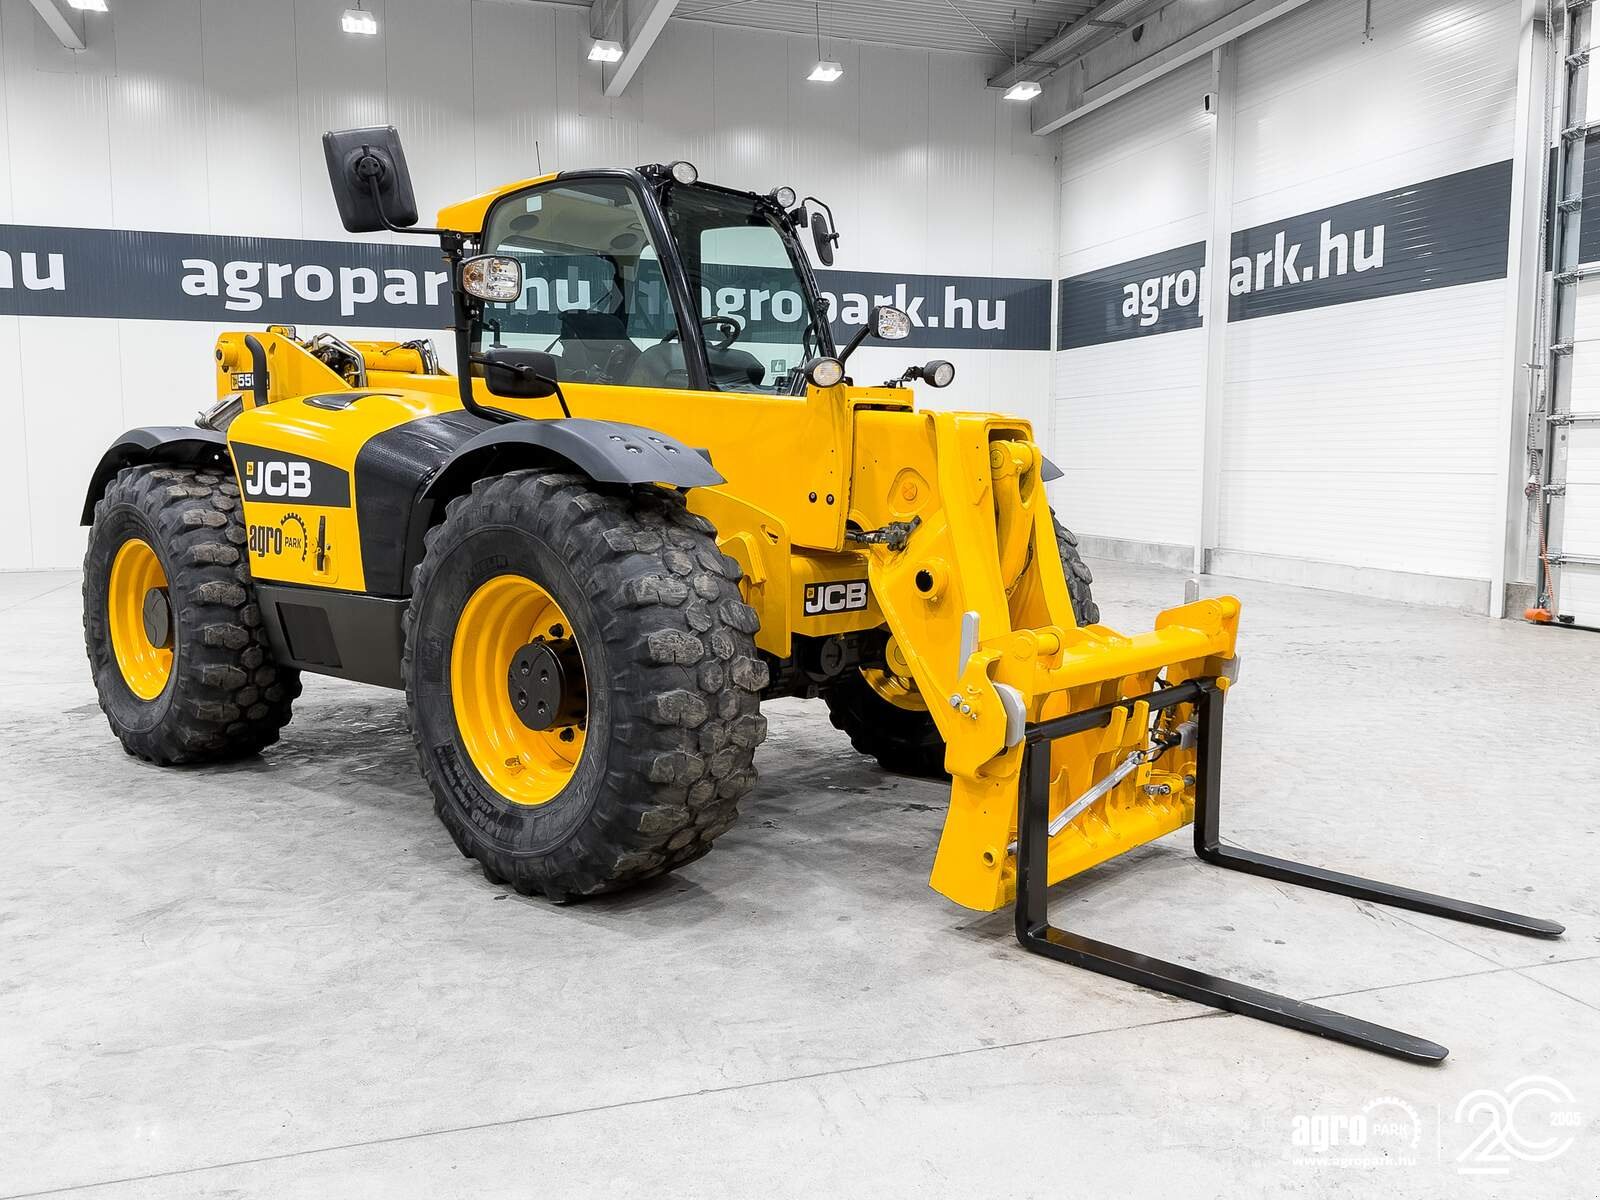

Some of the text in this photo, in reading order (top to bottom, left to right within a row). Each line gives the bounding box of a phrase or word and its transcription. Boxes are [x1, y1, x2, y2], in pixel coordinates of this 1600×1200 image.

[1122, 219, 1385, 326] agroark.hu
[246, 461, 311, 498] JCB
[249, 523, 302, 557] agro PARK
[805, 582, 867, 613] JCB
